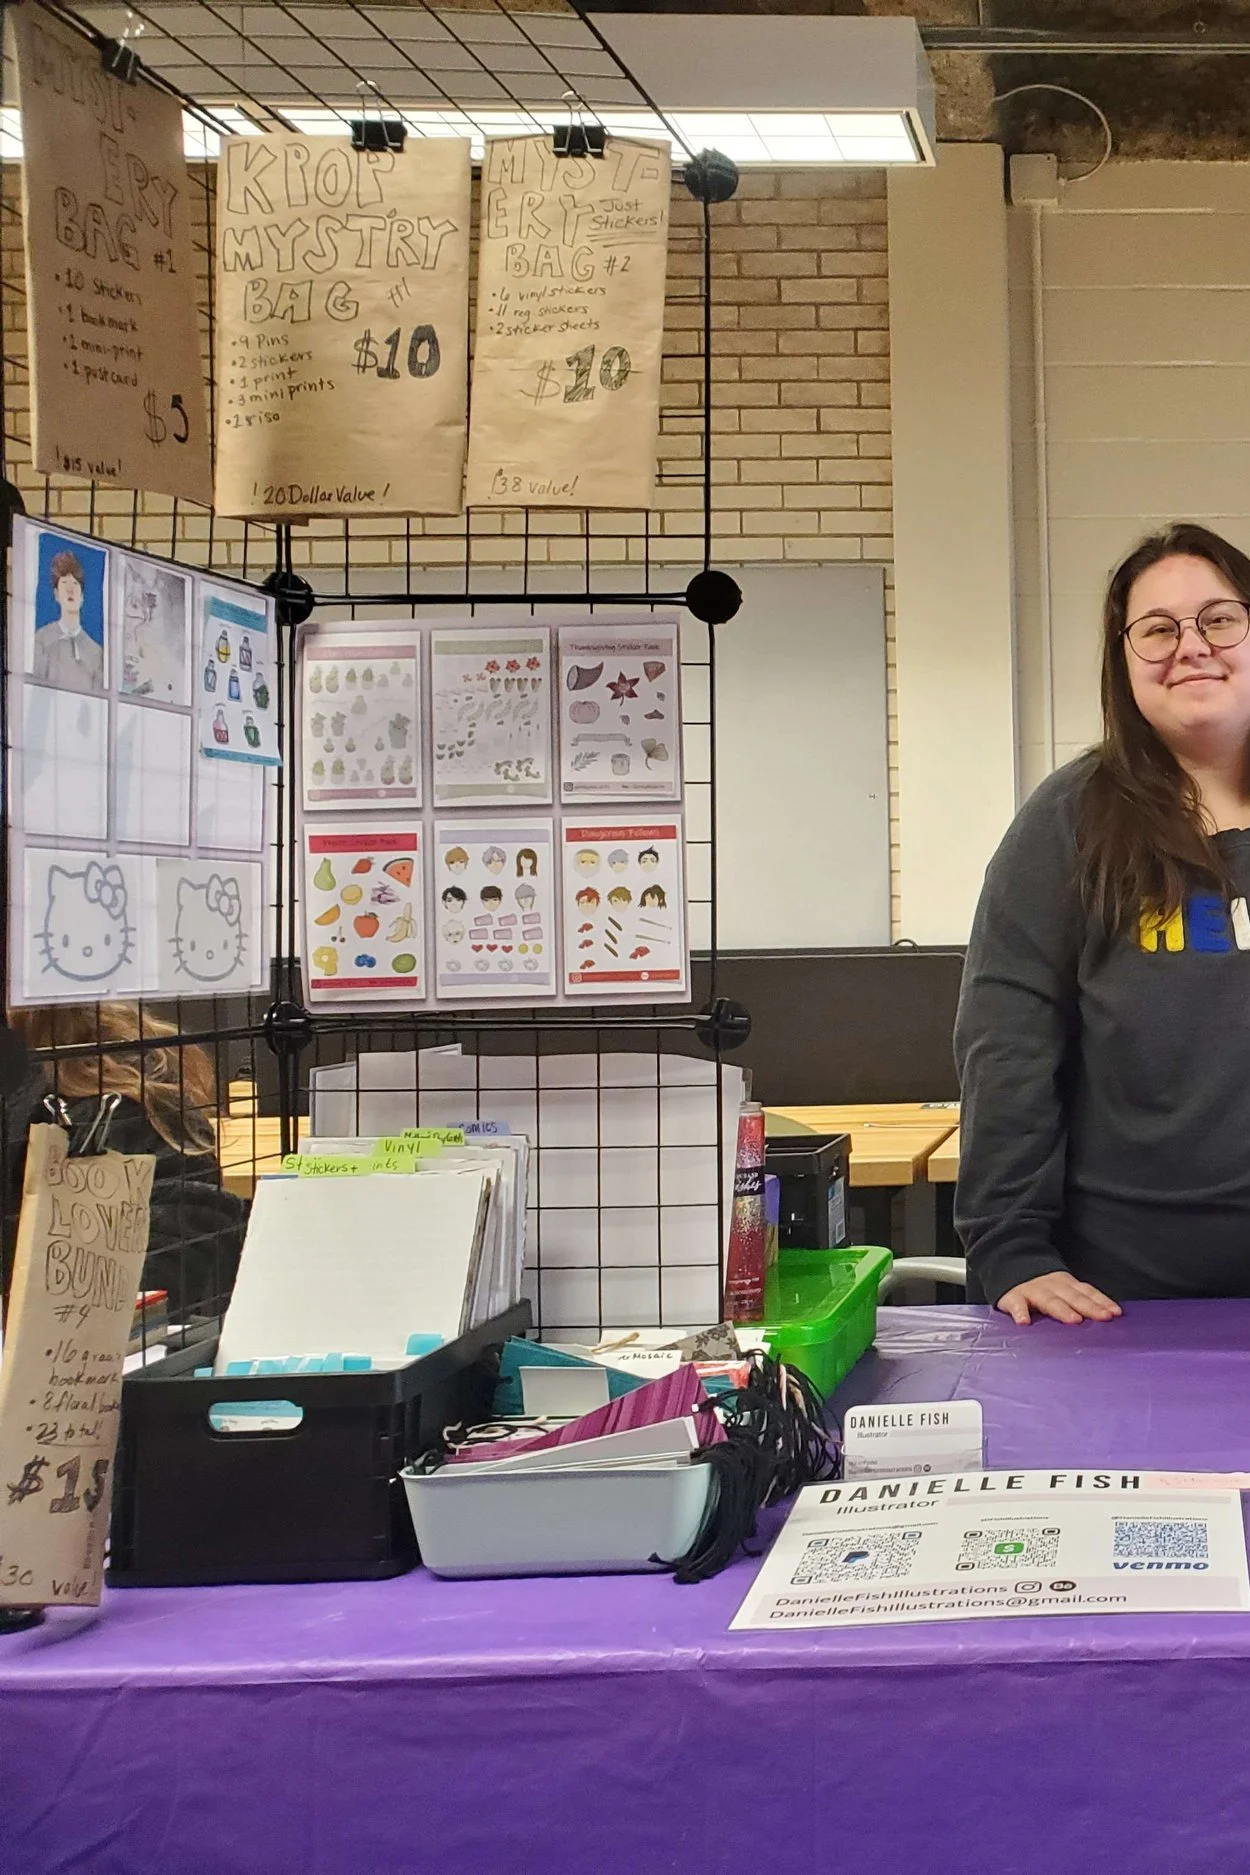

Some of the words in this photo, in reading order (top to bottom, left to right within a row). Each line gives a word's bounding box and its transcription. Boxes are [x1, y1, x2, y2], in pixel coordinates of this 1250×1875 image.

[226, 142, 396, 214] KPOP
[487, 186, 595, 249] ERY
[598, 197, 643, 213] Just
[54, 186, 140, 271] BAG
[504, 242, 596, 283] BAG
[603, 255, 632, 277] #2
[243, 277, 360, 324] BAG
[549, 284, 608, 298] stickers
[250, 350, 313, 370] stickers
[351, 323, 441, 380] $10
[253, 367, 299, 391] print
[287, 377, 336, 400] prints
[518, 343, 632, 407] $10
[143, 388, 190, 449] $5
[384, 1139, 421, 1155] Vinyl
[45, 1145, 151, 1204] BOOK
[632, 1352, 673, 1360] Mosaic
[850, 1413, 914, 1429] DANIELLE
[920, 1412, 950, 1426] FISH
[820, 1475, 1025, 1504] DANIELLE
[1050, 1474, 1141, 1490] FISH
[837, 1500, 939, 1515] Illustrator
[1113, 1561, 1209, 1571] venmo
